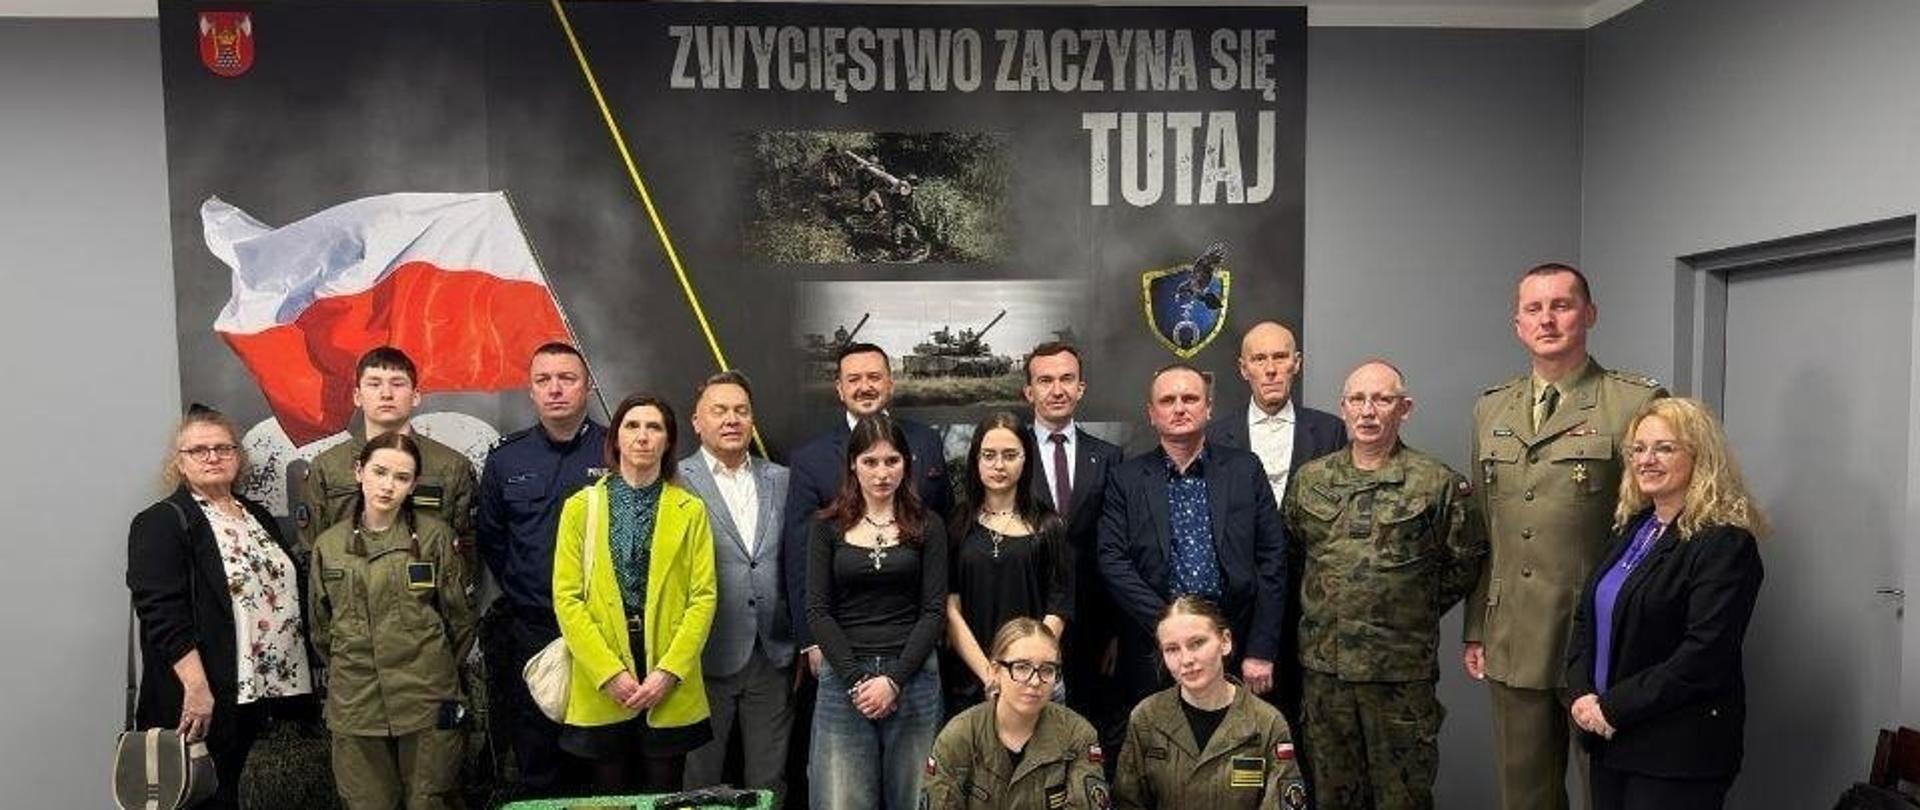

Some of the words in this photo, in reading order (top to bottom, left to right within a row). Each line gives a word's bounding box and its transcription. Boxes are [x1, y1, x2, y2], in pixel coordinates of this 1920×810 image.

[669, 25, 982, 103] ZWYCIĘSTWO
[995, 28, 1198, 92] ZACZYNA
[1210, 28, 1276, 101] SIĘ
[1082, 110, 1276, 207] TUTAJ
